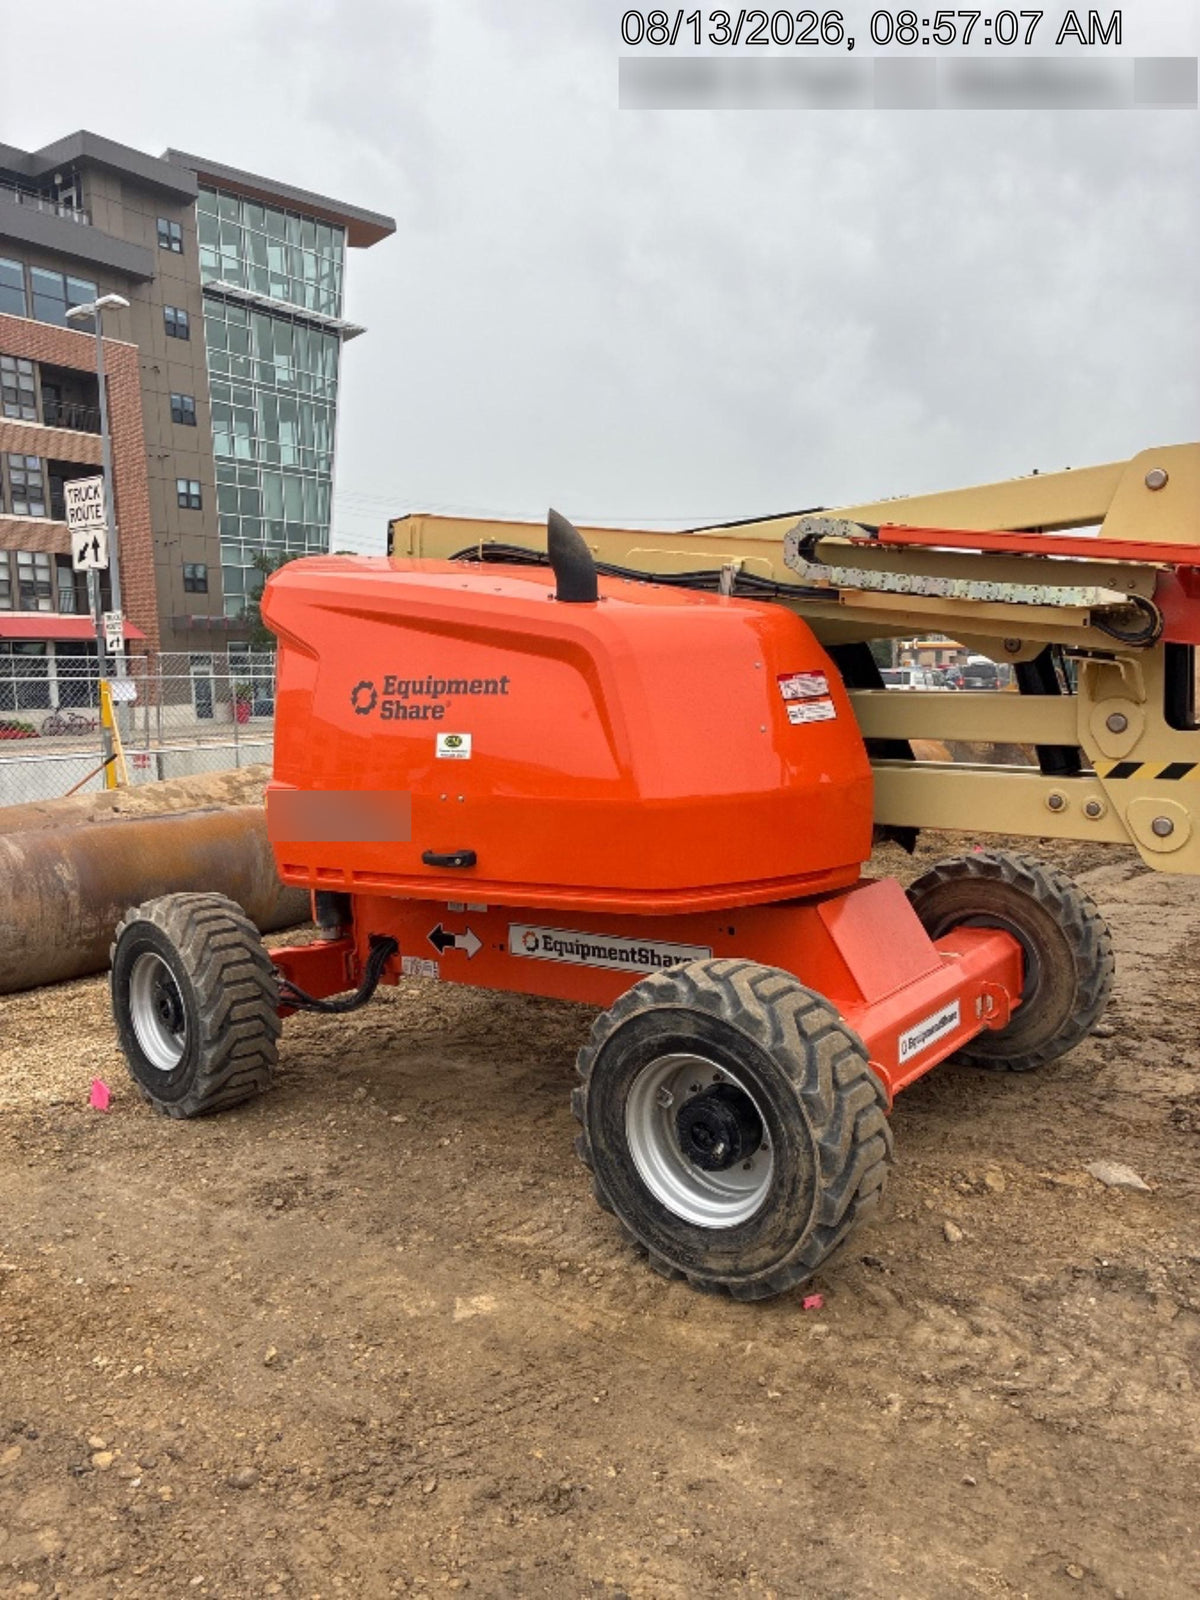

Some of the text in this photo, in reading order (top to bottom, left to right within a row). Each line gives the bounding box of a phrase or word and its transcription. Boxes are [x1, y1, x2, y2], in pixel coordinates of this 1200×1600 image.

[67, 484, 101, 504] TRUCK
[69, 503, 102, 523] ROUTE
[382, 675, 510, 699] Equipment
[380, 700, 445, 720] Share
